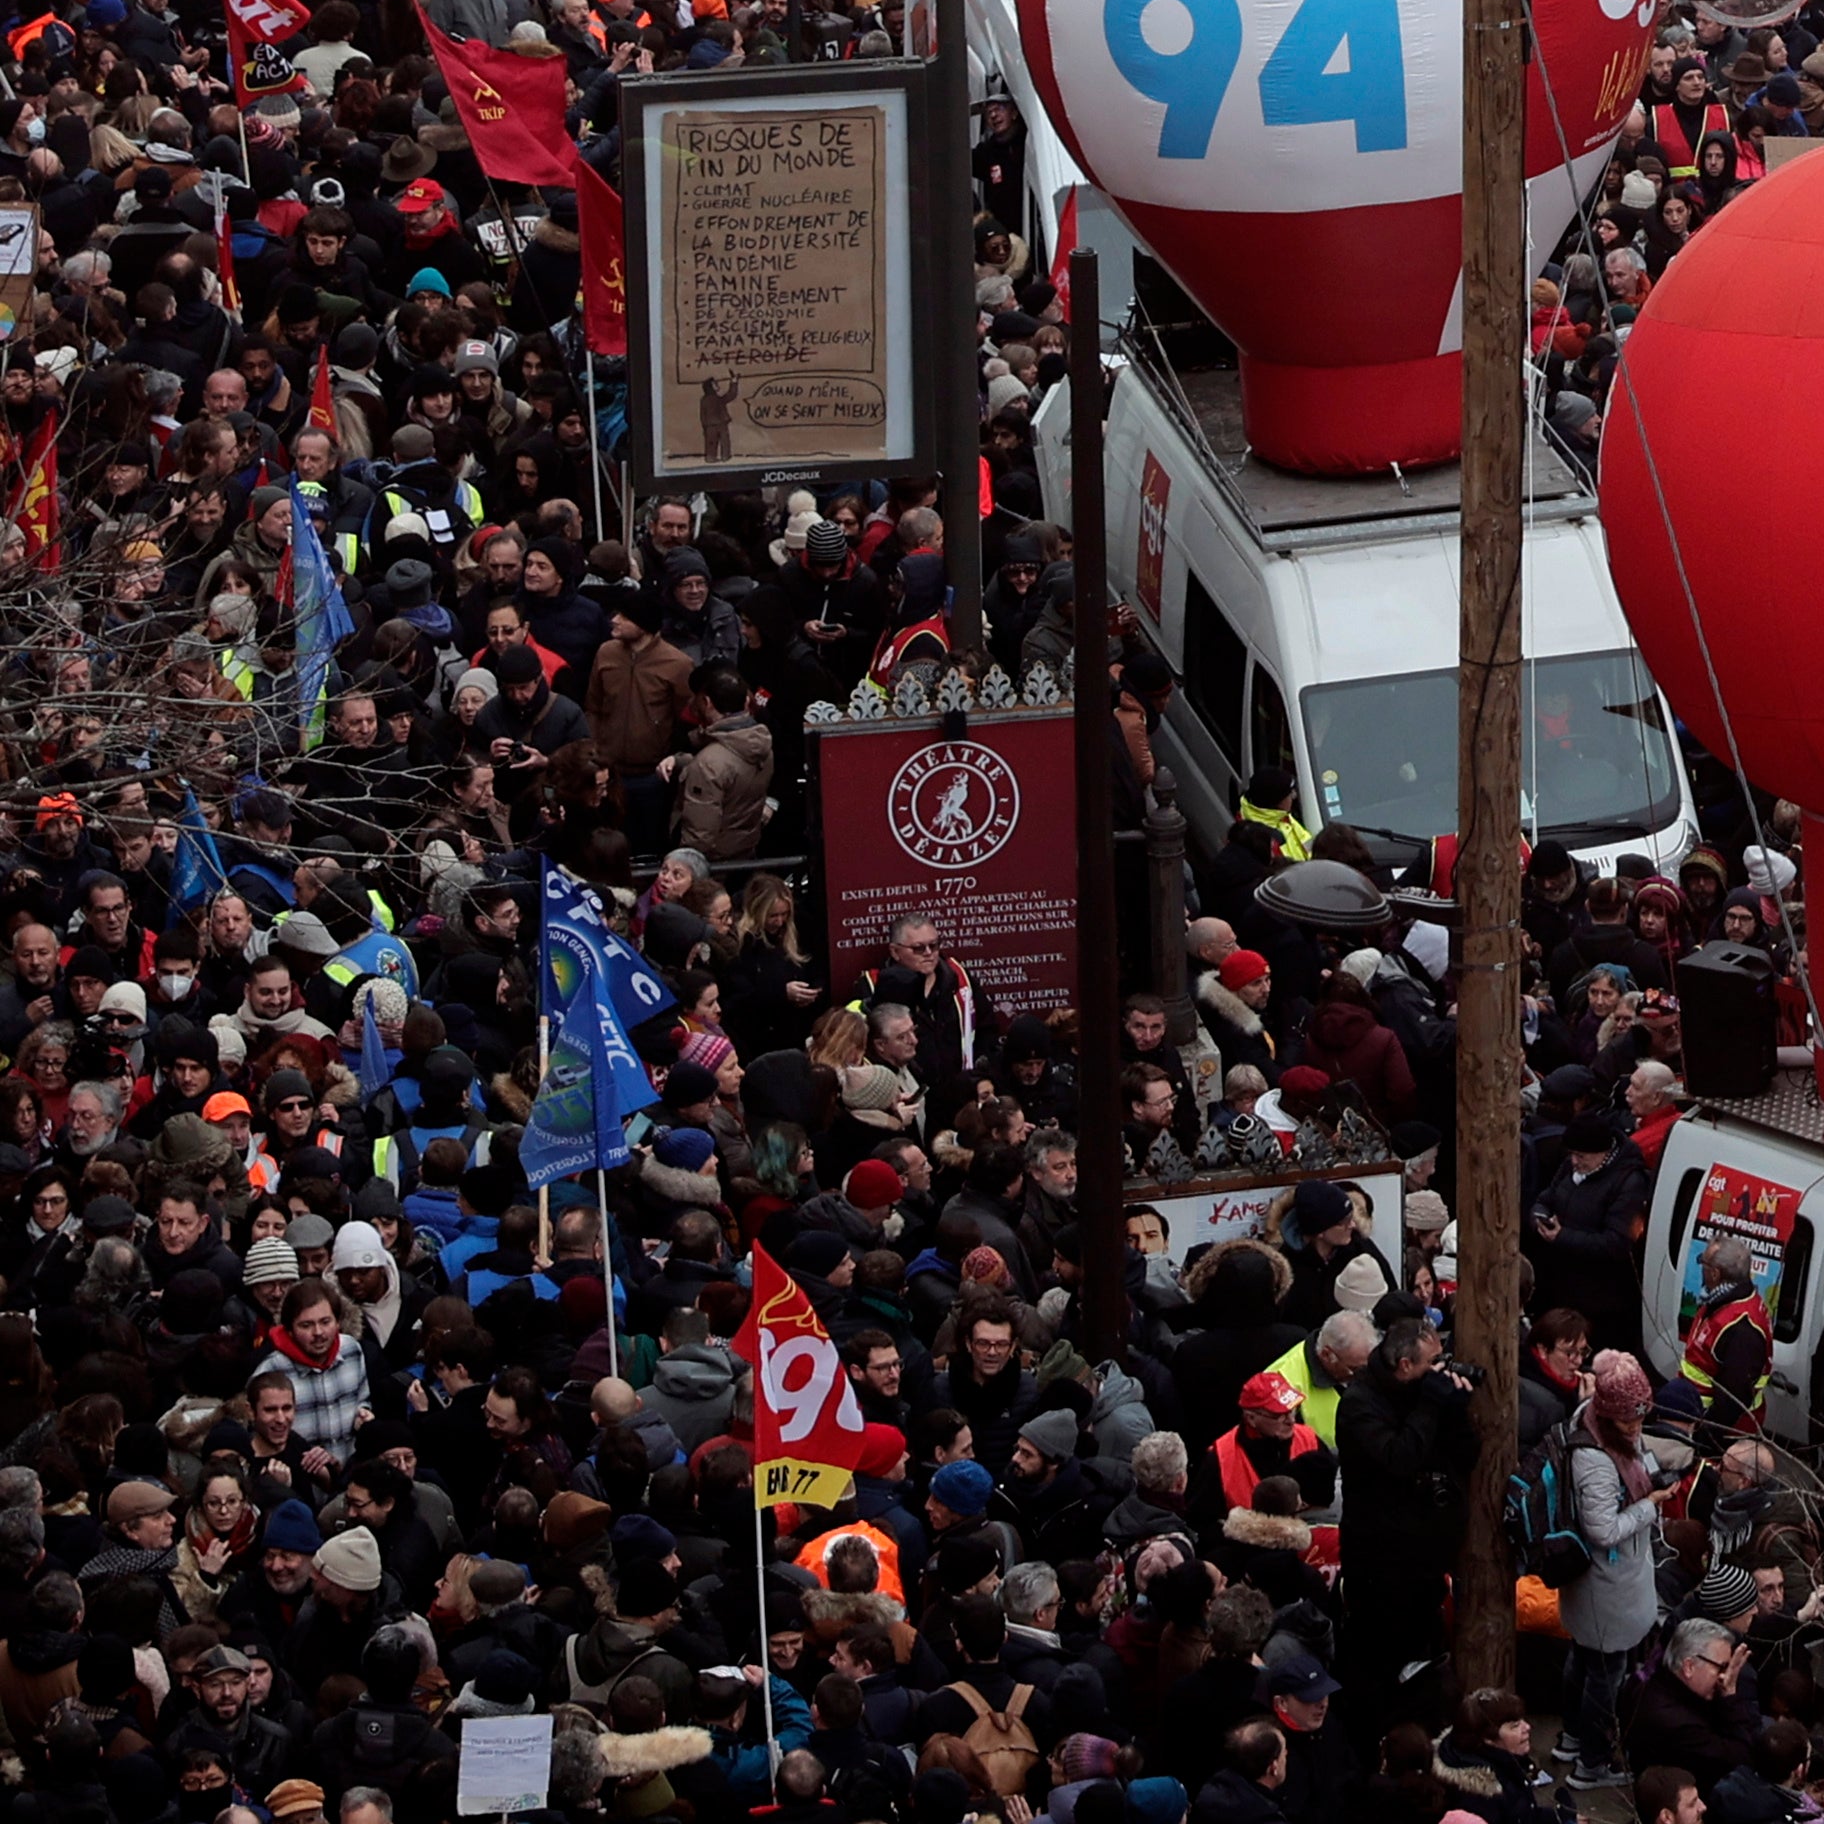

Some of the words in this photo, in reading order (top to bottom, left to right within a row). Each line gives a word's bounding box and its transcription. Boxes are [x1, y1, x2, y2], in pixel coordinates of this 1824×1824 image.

[690, 124, 803, 154] RISQUES
[819, 122, 852, 147] DE
[686, 157, 725, 178] FIN
[735, 154, 762, 177] DU
[772, 147, 857, 174] MONDE
[692, 197, 752, 211] GUERRE
[760, 188, 854, 209] NUCLÉAIRE
[693, 181, 756, 197] CLIMAT
[694, 211, 841, 232] EFFONDREMENT
[847, 210, 869, 228] DE
[691, 234, 712, 252] LA
[723, 228, 861, 252] BIODIVERSITÉ
[694, 273, 781, 293] FAMINE
[695, 287, 848, 310] EFFONDREMENT
[695, 310, 717, 321] DE
[695, 319, 789, 335] FASCISME
[695, 332, 797, 350] FANATISME
[801, 328, 872, 347] RELIGIEUX
[760, 385, 805, 399] QUAND
[753, 405, 772, 420] ON
[774, 405, 789, 419] SE
[792, 403, 829, 420] SENT
[832, 403, 882, 419] MIEUX
[760, 470, 822, 484] JCDecaux
[1141, 494, 1163, 557] cgt
[897, 744, 1007, 793] THÉÂTRE
[898, 813, 1010, 865] DÉJAZET
[840, 886, 886, 902] EXISTE
[885, 882, 929, 898] DEPUIS
[934, 875, 978, 897] 1770
[868, 903, 885, 914] CE
[918, 897, 957, 911] AYANT
[959, 890, 1029, 907] APPARTENU
[1029, 889, 1047, 901] AU
[842, 914, 886, 928] COMTE
[991, 901, 1013, 913] ROI
[1014, 898, 1070, 913] CHARLES
[961, 910, 1044, 927] DÉMOLITIONS
[1044, 909, 1069, 921] SUR
[958, 928, 974, 939] LE
[975, 923, 1017, 937] BARON
[836, 939, 853, 950] CE
[959, 952, 1067, 969] ARIE-ANTOINETTE,
[979, 973, 1029, 987] PARADIS
[994, 990, 1026, 1004] REÇU
[1028, 988, 1070, 1001] DEPUIS
[1706, 1174, 1728, 1194] cgt
[1207, 1196, 1268, 1224] KAME
[1697, 1224, 1714, 1240] DE
[1708, 1211, 1737, 1228] POUR
[1735, 1217, 1779, 1239] PROFITER
